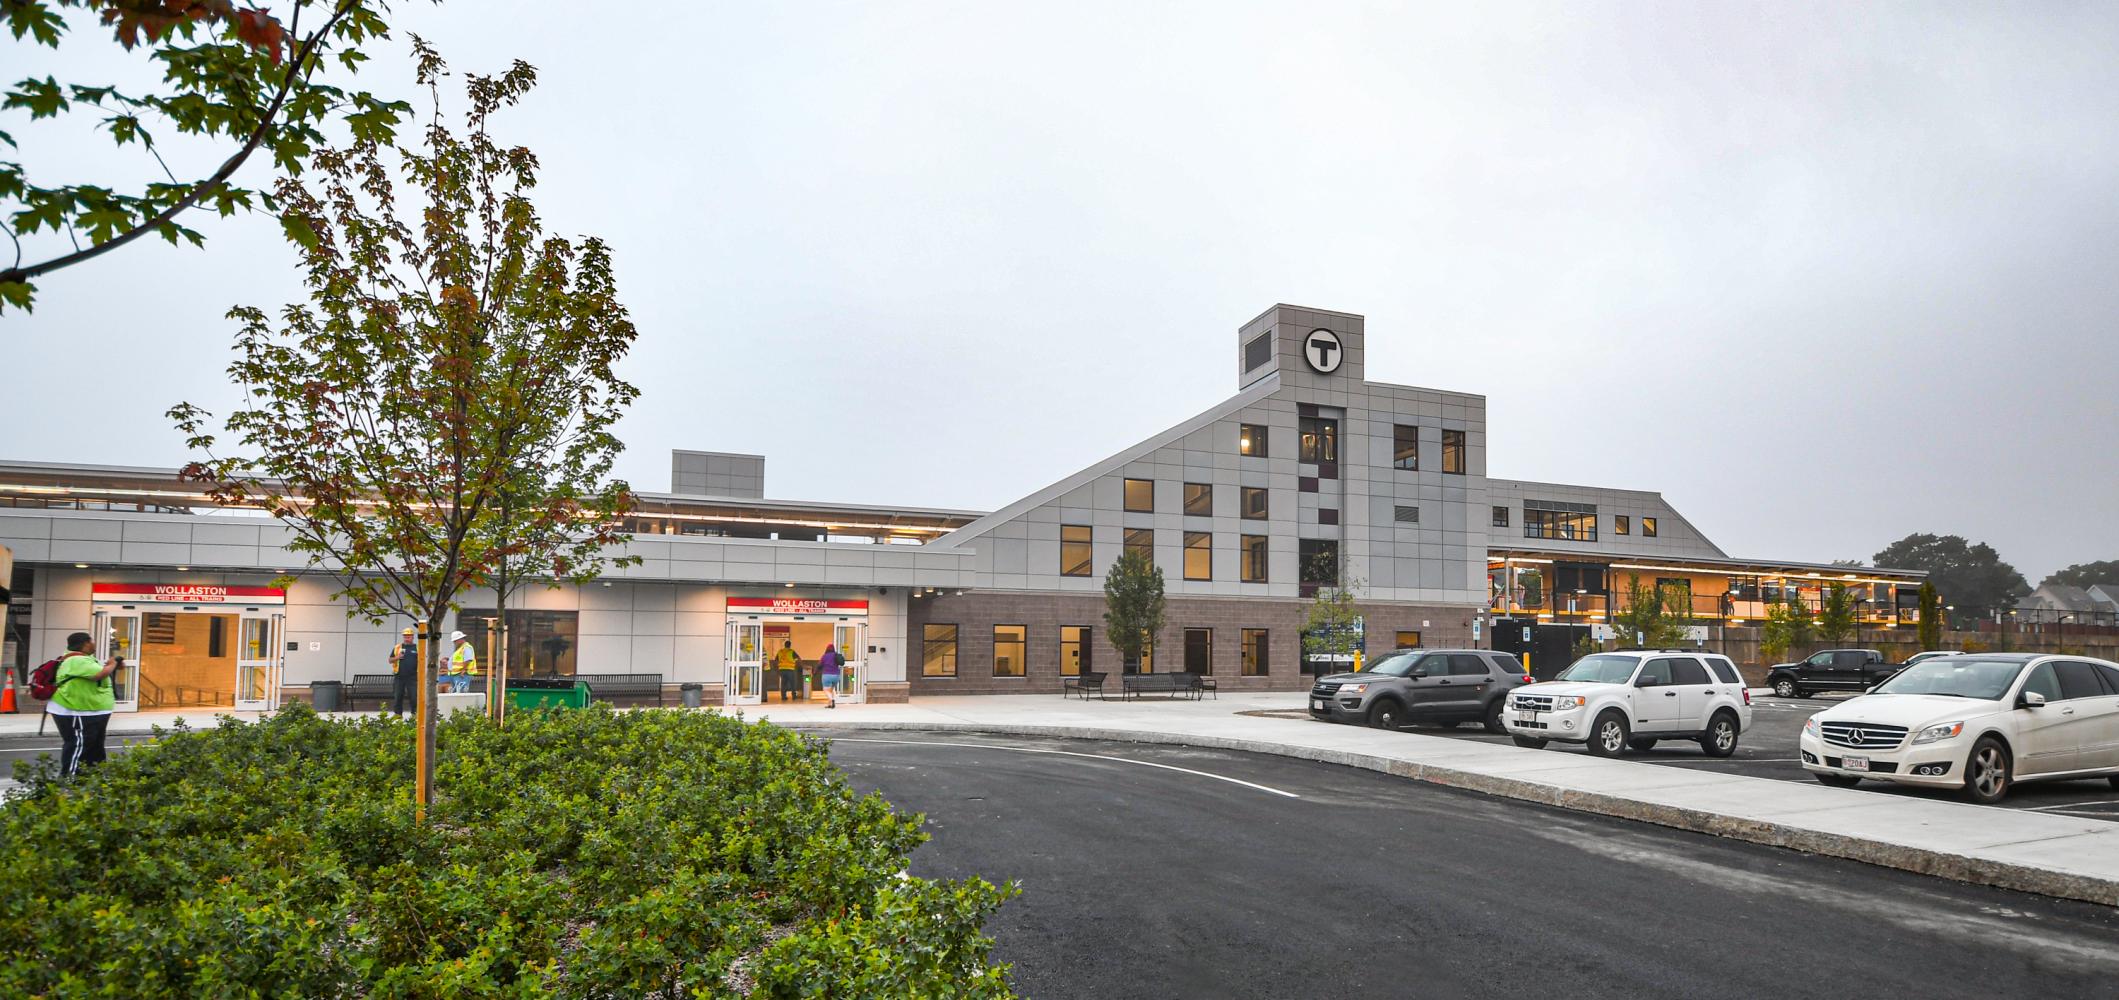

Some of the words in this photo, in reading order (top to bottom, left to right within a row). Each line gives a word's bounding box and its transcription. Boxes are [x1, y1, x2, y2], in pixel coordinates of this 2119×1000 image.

[1311, 339, 1337, 367] T
[155, 586, 227, 595] WOLLASTON
[772, 600, 828, 608] WOLLASTON
